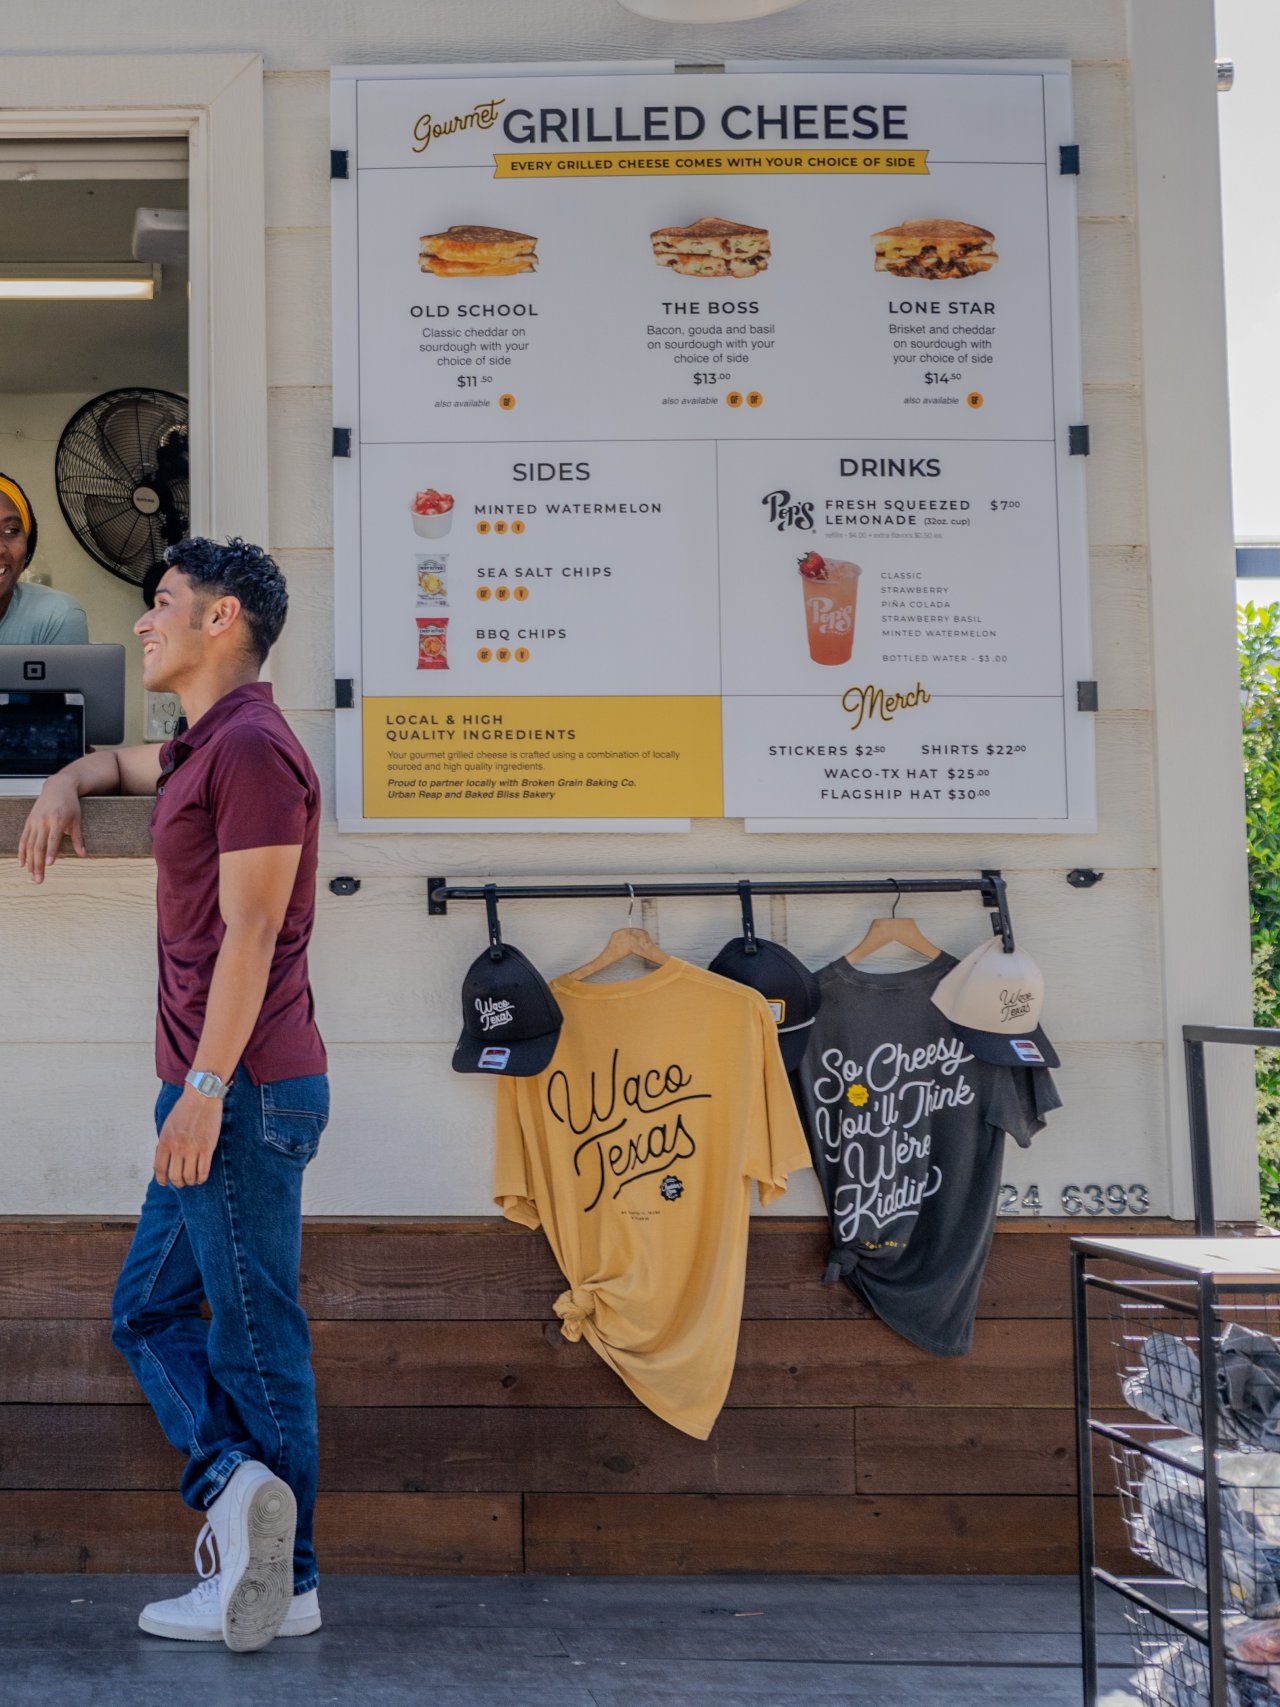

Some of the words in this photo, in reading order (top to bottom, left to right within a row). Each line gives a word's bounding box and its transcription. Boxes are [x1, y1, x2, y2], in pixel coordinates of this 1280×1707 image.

[412, 98, 506, 153] Gourmet
[503, 106, 705, 144] GRILLED
[721, 104, 909, 141] CHEESE
[511, 161, 553, 172] EVERY
[557, 160, 613, 170] GRILLED
[618, 159, 670, 170] CHEESE
[675, 158, 722, 168] COMES
[727, 158, 762, 168] WITH
[766, 157, 803, 168] YOUR
[808, 157, 858, 168] CHOICE
[863, 157, 881, 167] OF
[886, 157, 916, 167] SIDE
[410, 305, 450, 318] OLD
[457, 303, 539, 317] SCHOOL
[661, 302, 701, 315] THE
[708, 301, 760, 314] BOSS
[888, 301, 941, 314] LONE
[948, 301, 996, 315] STAR
[422, 327, 462, 338] Classic
[464, 326, 508, 338] cheddar
[511, 328, 526, 337] on
[419, 341, 477, 353] sourdough
[480, 341, 502, 351] with
[504, 342, 529, 353] your
[437, 356, 472, 366] choice
[475, 355, 486, 365] of
[489, 355, 512, 366] side
[693, 371, 731, 386] $13.00
[924, 371, 962, 385] $14.50
[512, 462, 591, 482] SIDES
[839, 458, 942, 478] DRINKS
[474, 503, 538, 515] MINTED
[546, 503, 662, 514] WATERMELON
[825, 500, 878, 511] FRESH
[884, 500, 970, 511] SQUEEZED
[825, 515, 918, 526] LEMONADE
[951, 517, 971, 528] cup)
[477, 567, 509, 578] SEA
[515, 567, 553, 578] SALT
[562, 567, 612, 578] CHIPS
[880, 572, 923, 580] CLASSIC
[881, 587, 949, 595] STRAWBERRY
[881, 599, 906, 609] PIÑA
[909, 601, 951, 609] COLADA
[881, 615, 950, 623] STRAWBERRY
[476, 629, 510, 641] BBQ
[517, 629, 568, 640] CHIPS
[882, 630, 921, 638] MINTED
[926, 630, 997, 638] WATERMELON
[882, 655, 929, 663] BOTTLED
[933, 655, 967, 663] WATER
[842, 682, 932, 731] Merch
[386, 715, 439, 726] LOCAL
[446, 715, 456, 725] &
[463, 715, 503, 725] HIGH
[386, 730, 456, 741] QUALITY
[464, 729, 576, 740] INGREDIENTS
[769, 746, 848, 757] STICKERS
[922, 745, 979, 756] SHIRTS
[986, 744, 1026, 756] $22.00
[824, 768, 901, 780] WACO-TX
[907, 768, 938, 780] HAT
[948, 768, 990, 780] $25.00
[387, 790, 418, 799] Urban
[419, 790, 442, 801] Reap
[444, 790, 463, 799] and
[464, 790, 495, 799] Baked
[497, 790, 521, 799] Bliss
[523, 790, 556, 801] Bakery
[821, 789, 902, 800] FLAGSHIP
[910, 789, 942, 800] HAT
[948, 789, 990, 801] $30.00
[475, 997, 516, 1014] Waco
[480, 1010, 513, 1031] Texas
[814, 1048, 863, 1104] So
[866, 1037, 976, 1092] Cheesy
[548, 1048, 712, 1135] Waco
[815, 1092, 899, 1163] You'll
[898, 1075, 976, 1129] Think
[574, 1113, 696, 1213] Texas
[1061, 1184, 1150, 1216] 6393
